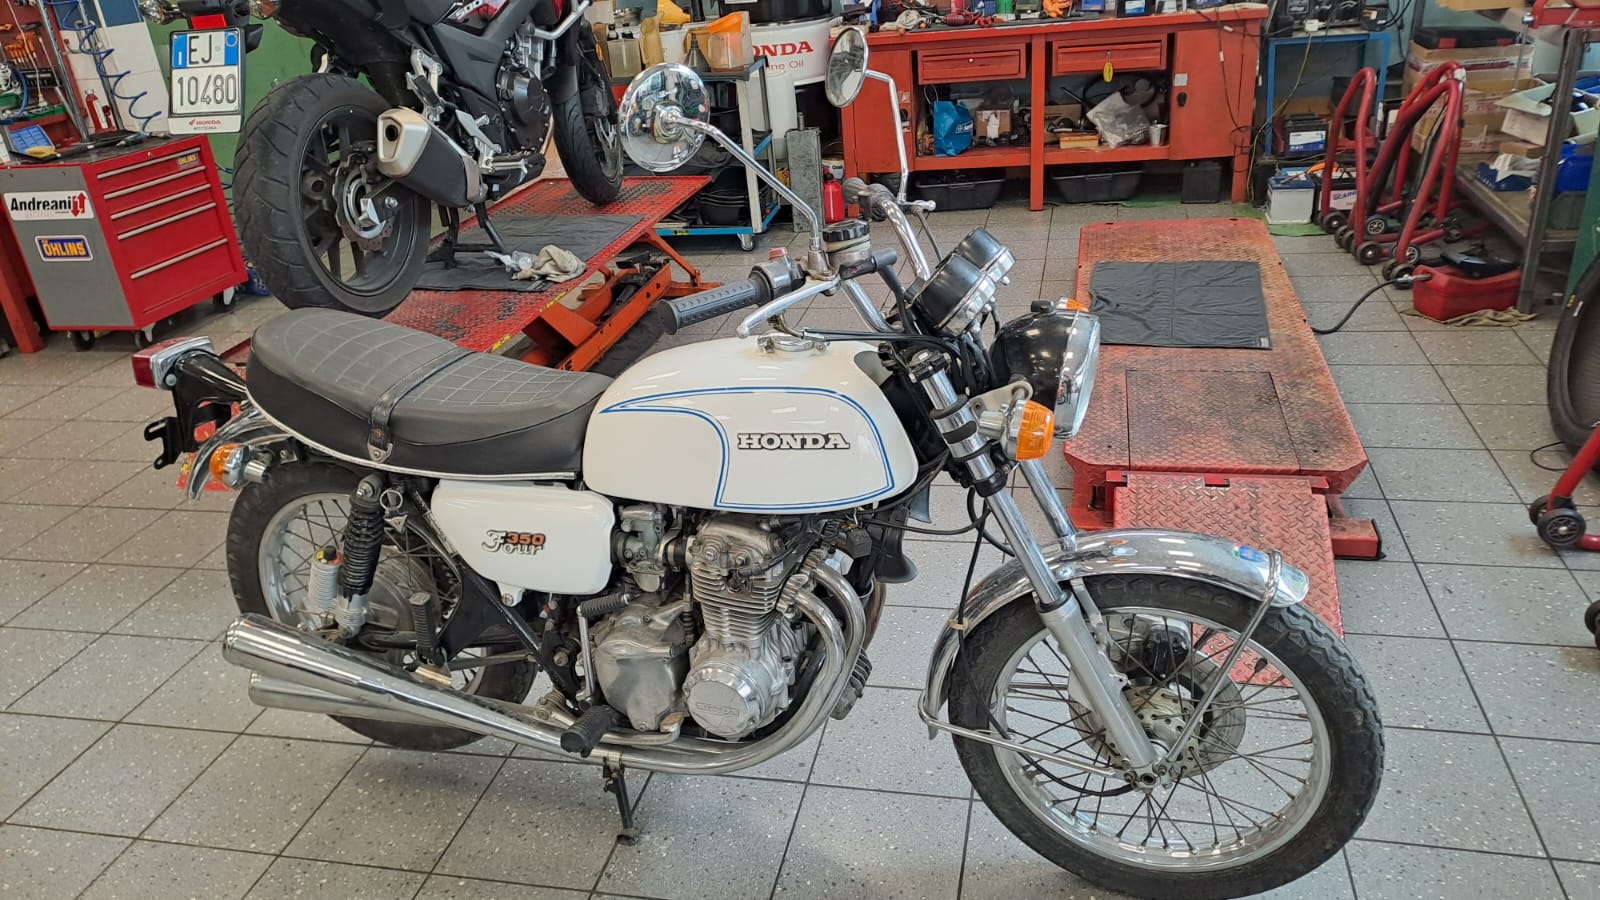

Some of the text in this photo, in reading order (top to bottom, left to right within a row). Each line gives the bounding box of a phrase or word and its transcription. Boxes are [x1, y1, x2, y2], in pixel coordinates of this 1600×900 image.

[188, 35, 212, 65] EJ
[789, 60, 804, 69] Oil
[178, 74, 237, 106] 10480
[10, 196, 72, 211] Andreani
[41, 239, 87, 256] ÖHLINS
[737, 432, 851, 450] HONDA
[481, 529, 544, 555] Four
[506, 531, 546, 546] 350
